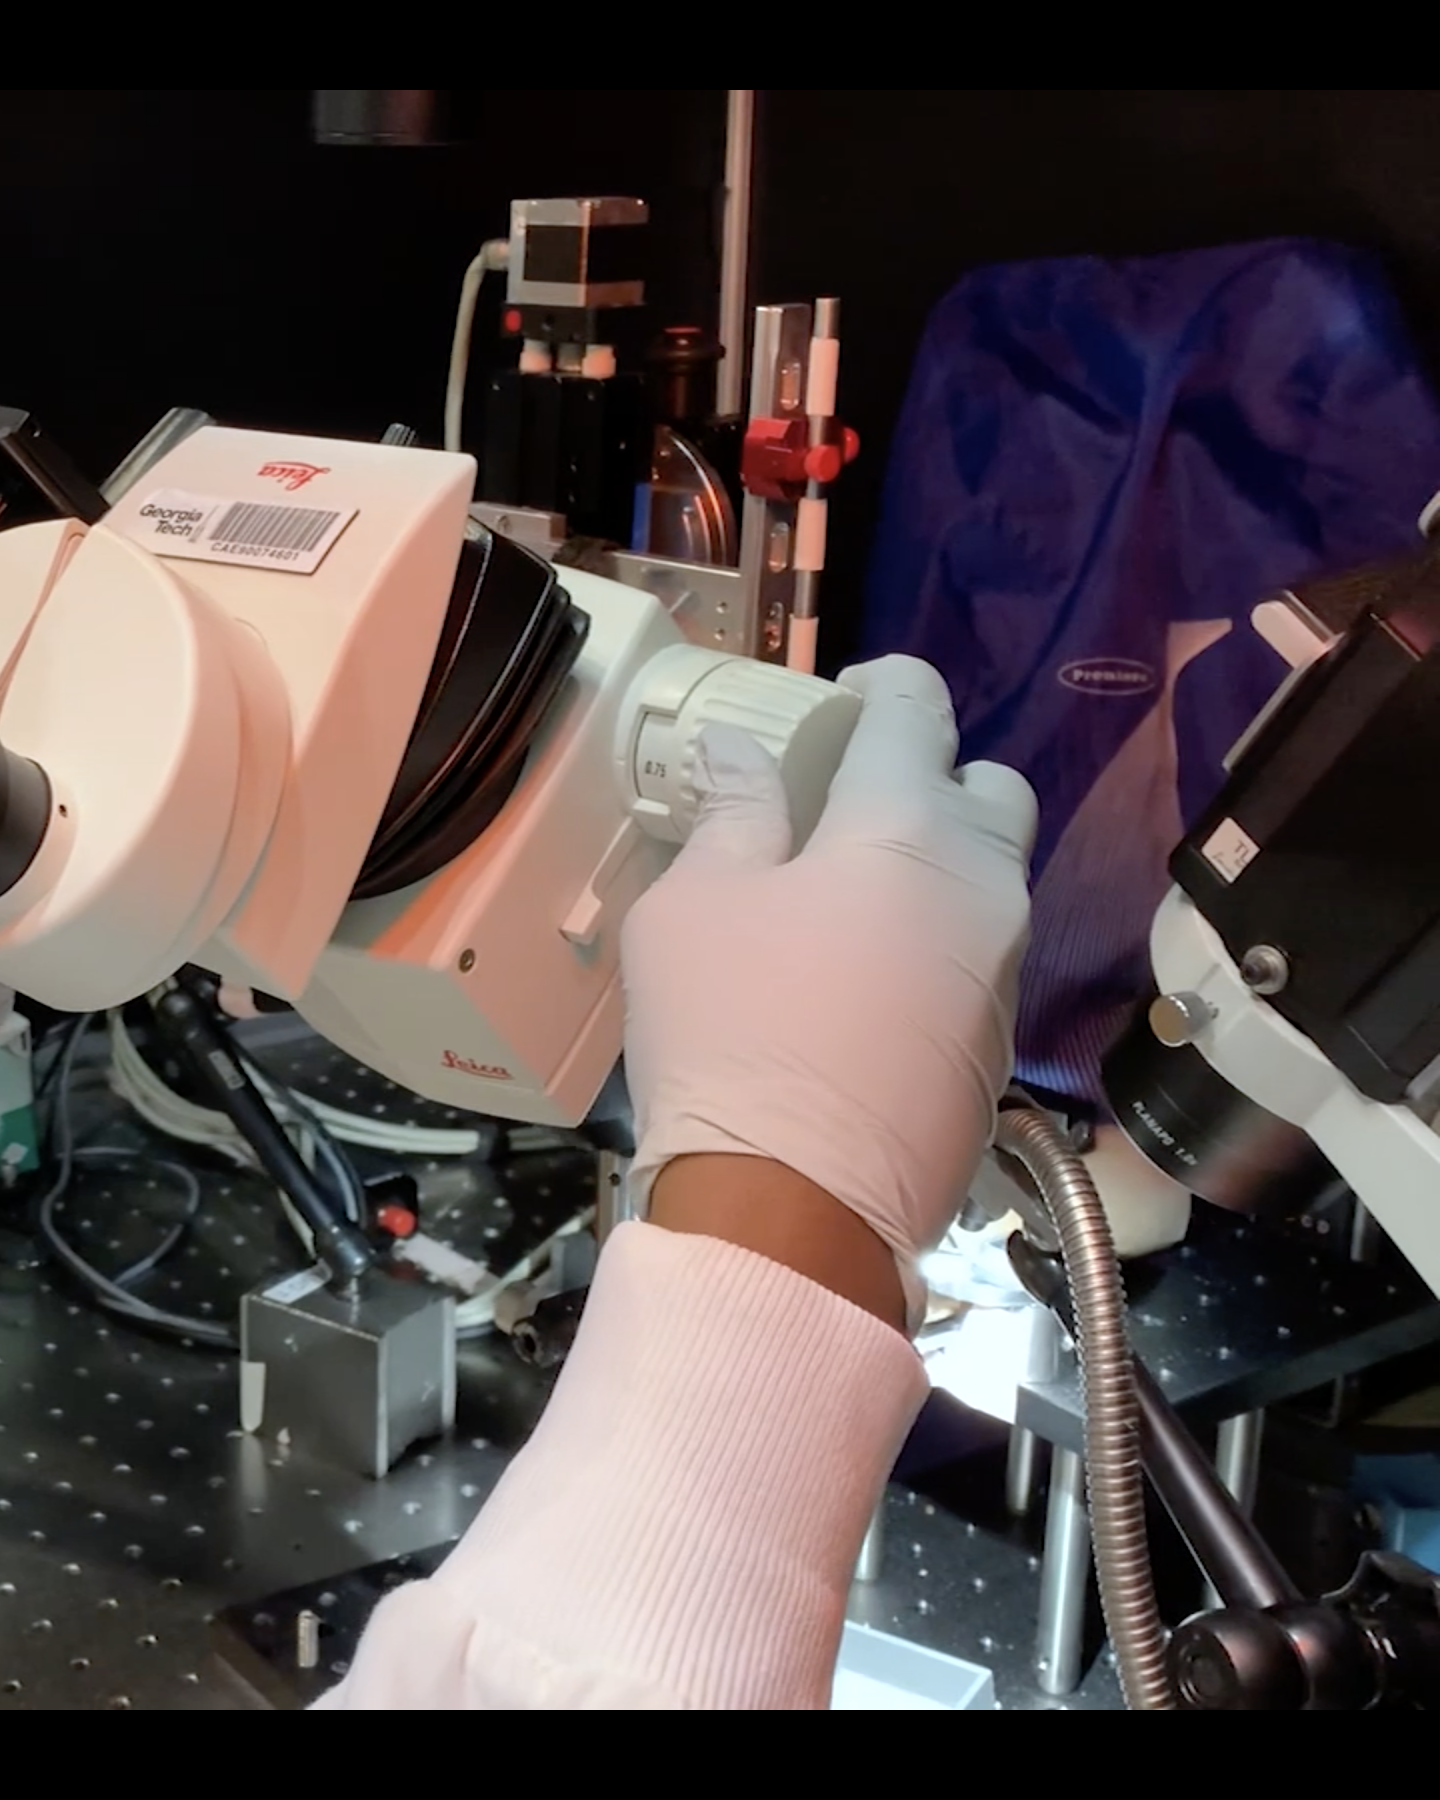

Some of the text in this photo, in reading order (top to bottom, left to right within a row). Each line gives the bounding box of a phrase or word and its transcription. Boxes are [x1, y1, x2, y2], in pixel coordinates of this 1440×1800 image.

[257, 461, 331, 491] Leica
[140, 503, 203, 523] Georgia
[155, 519, 193, 536] Tech
[441, 1049, 514, 1080] Leica
